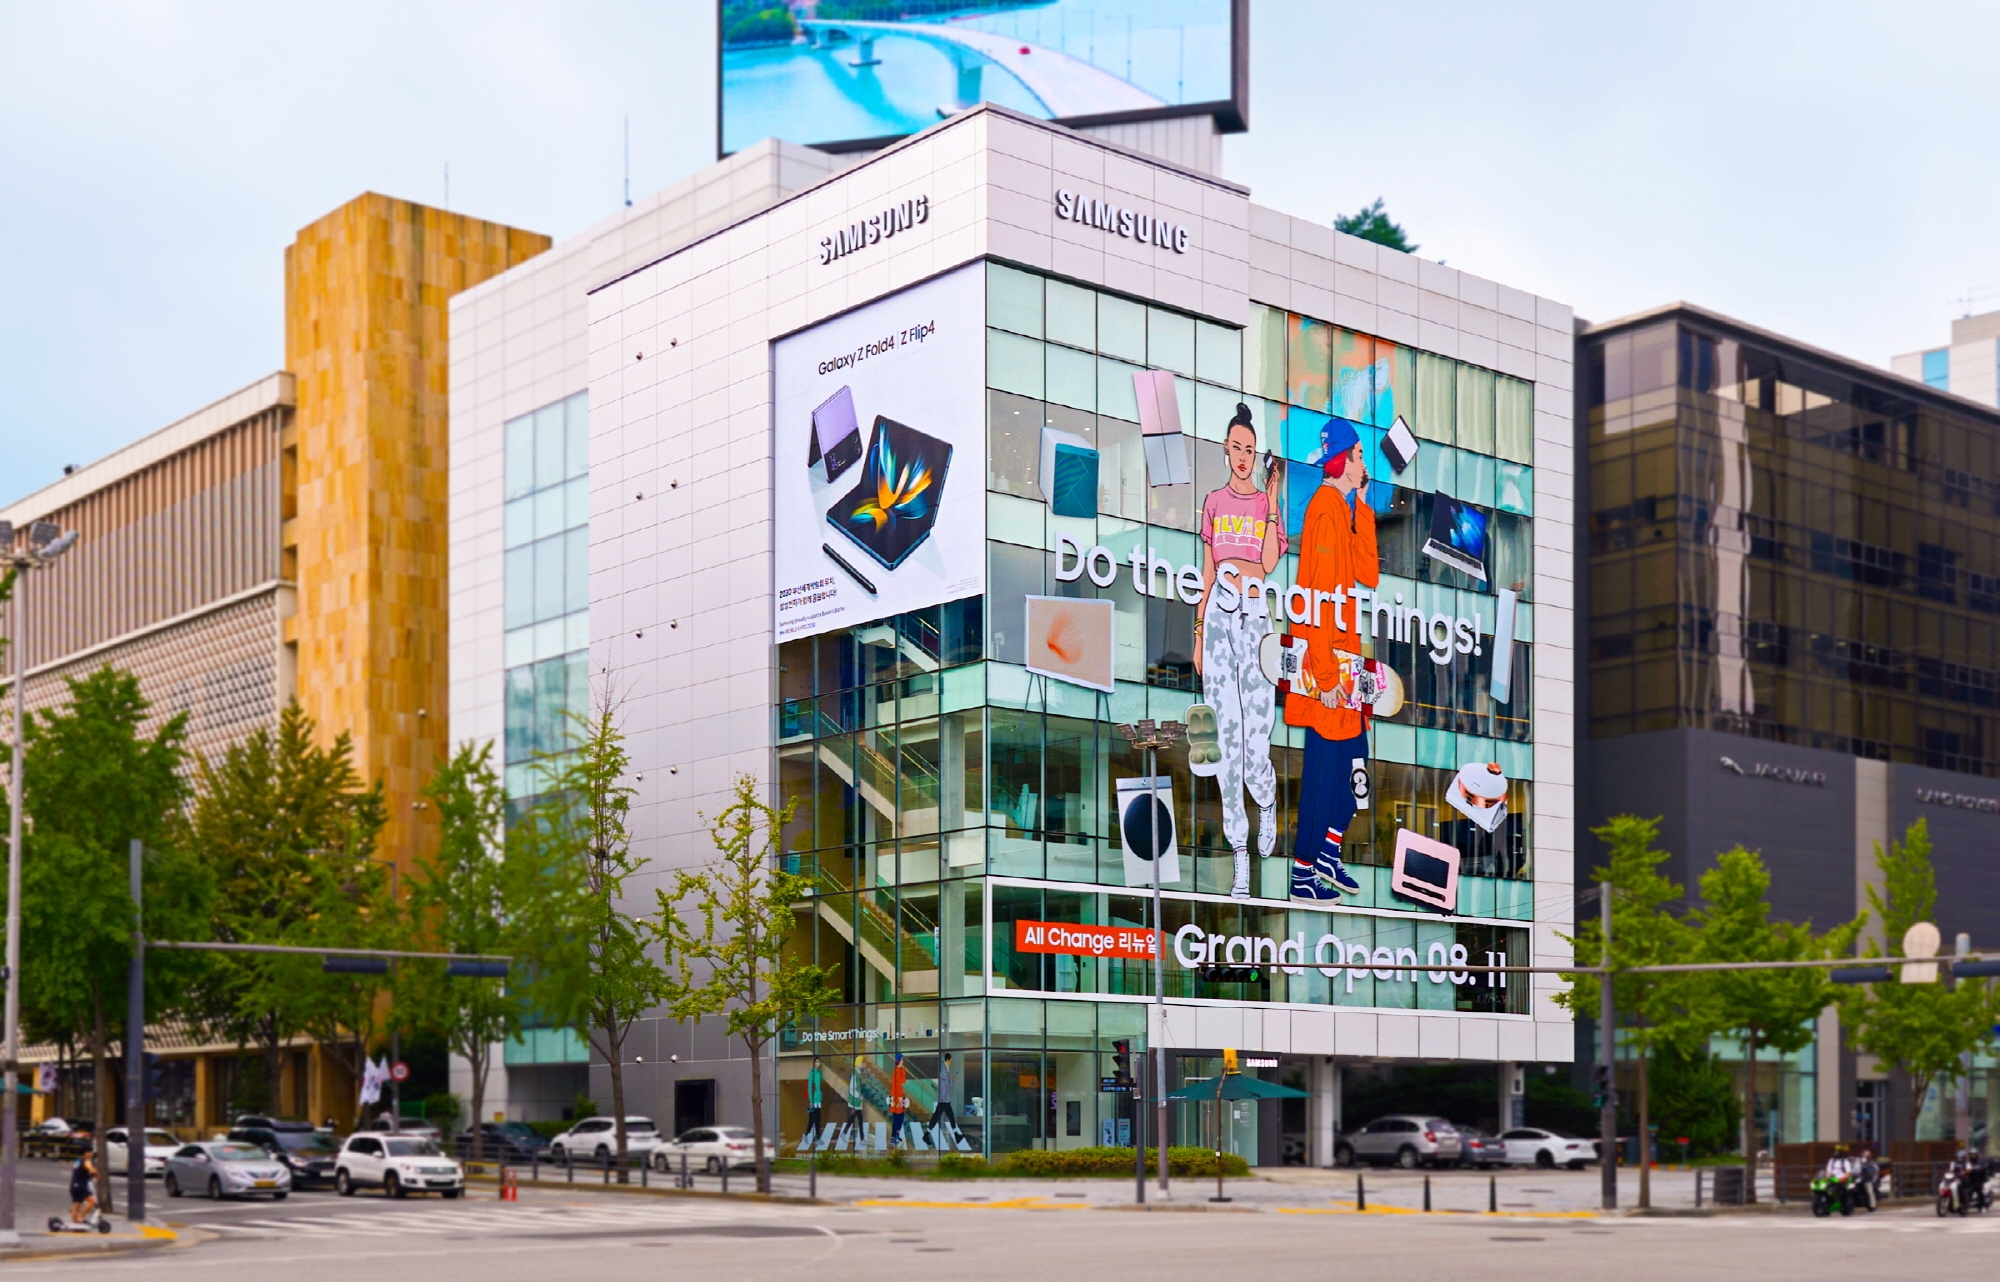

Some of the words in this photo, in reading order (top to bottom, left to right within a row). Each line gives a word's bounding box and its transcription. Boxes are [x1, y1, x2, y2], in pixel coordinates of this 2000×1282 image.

[818, 194, 929, 265] SAMSUNG
[1055, 189, 1190, 254] SAMSUNG
[818, 352, 857, 376] Galaxy
[857, 346, 864, 362] Z
[865, 334, 895, 359] Fold4
[900, 330, 908, 346] Z
[909, 319, 936, 344] Flip4
[1055, 530, 1117, 588] Do
[1127, 542, 1205, 606] the
[1215, 562, 1484, 666] SmartThings!
[1754, 762, 1827, 784] JAGUAR
[1024, 926, 1045, 945] All
[1047, 927, 1115, 954] Change
[1173, 923, 1305, 976] Grand
[1314, 933, 1419, 993] Open
[802, 1031, 813, 1042] Do
[814, 1031, 827, 1042] the
[1246, 1058, 1278, 1068] SAMSUNG
